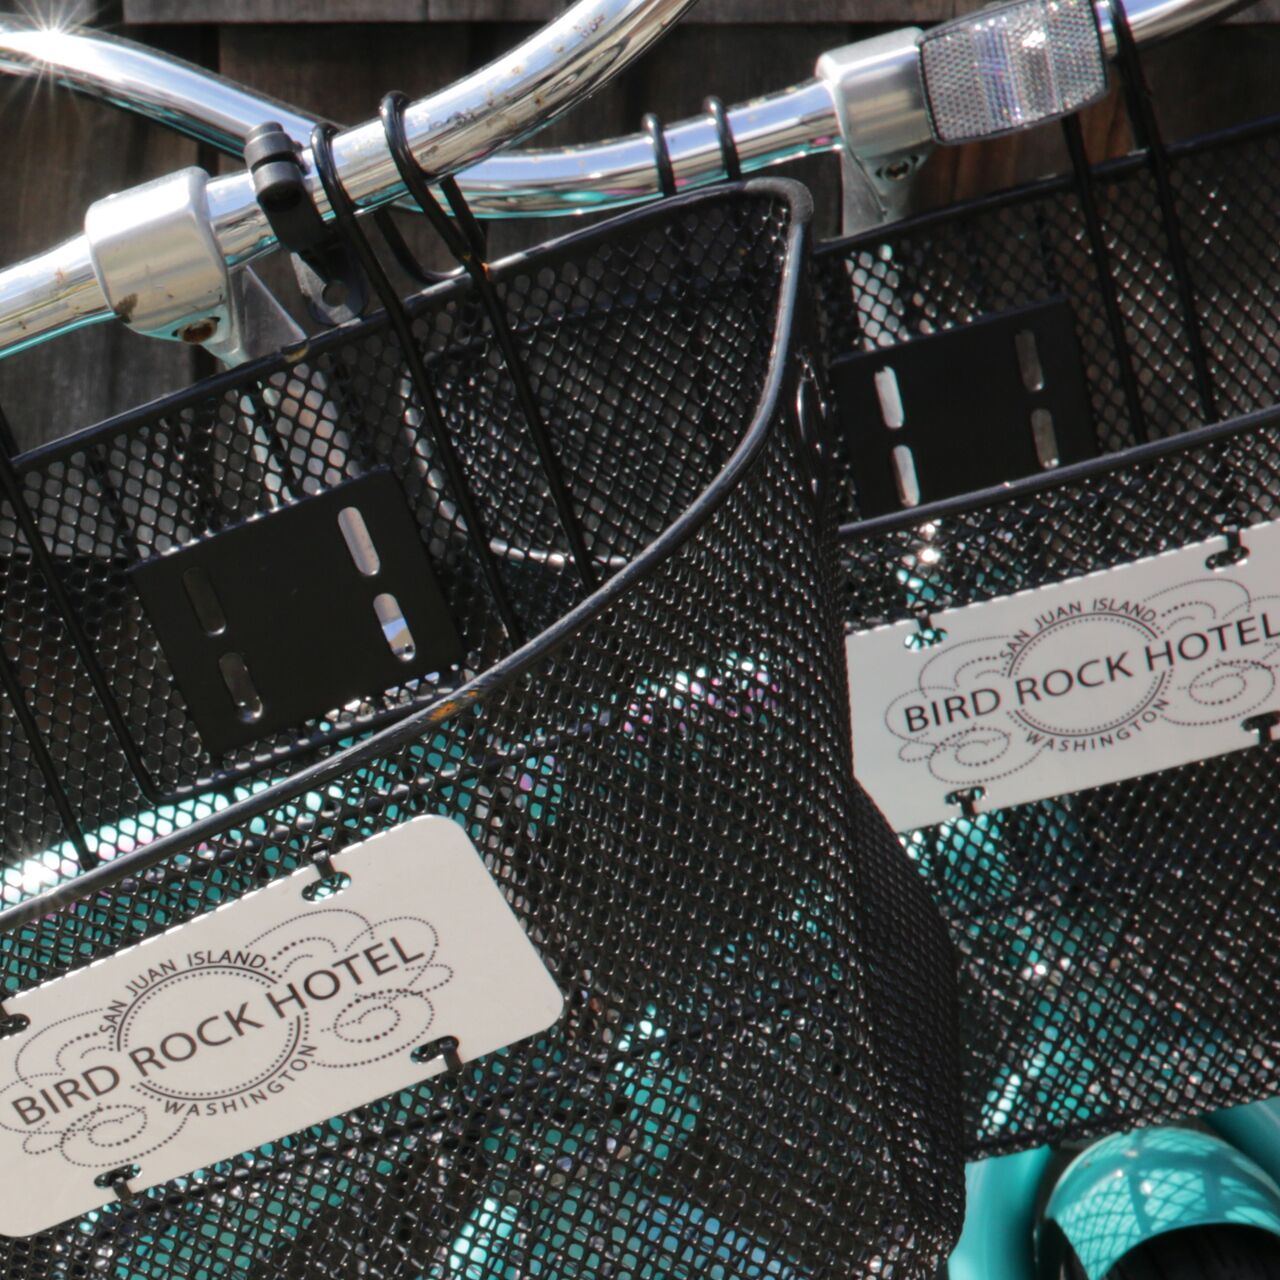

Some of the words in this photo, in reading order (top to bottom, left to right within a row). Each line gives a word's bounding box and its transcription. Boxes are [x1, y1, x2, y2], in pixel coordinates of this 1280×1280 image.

[1000, 629, 1030, 660] SAN
[1035, 600, 1082, 628] JUAN
[1093, 598, 1156, 622] ISLAND
[904, 688, 1001, 733] BIRD
[1015, 652, 1133, 705] ROCK
[1145, 613, 1280, 671] HOTEL
[1025, 698, 1170, 751] WASHINGTON
[99, 1000, 128, 1033] SAN
[125, 959, 178, 998] JUAN
[186, 949, 267, 970] ISLAND
[11, 1065, 120, 1126] BIRD
[128, 1002, 265, 1077] ROCK
[265, 936, 425, 1019] HOTEL
[164, 1044, 318, 1116] WASHINGTON
